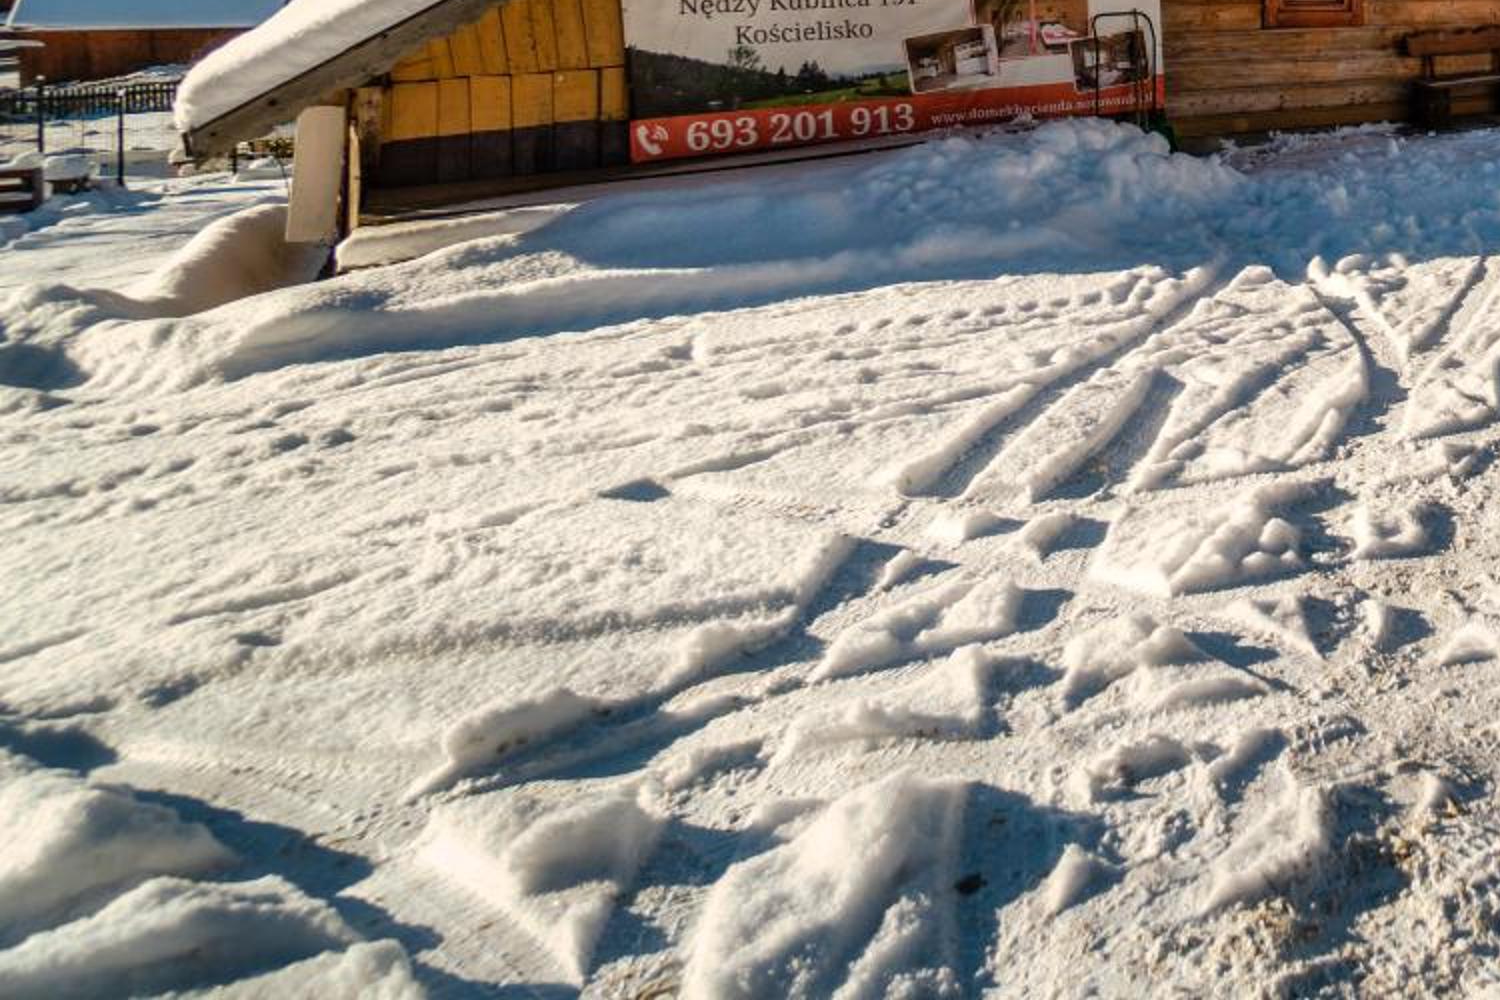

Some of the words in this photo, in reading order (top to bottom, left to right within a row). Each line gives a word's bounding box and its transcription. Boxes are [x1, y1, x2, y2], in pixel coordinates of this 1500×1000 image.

[735, 20, 874, 45] Kościelisko
[686, 117, 758, 151] 693
[769, 109, 840, 143] 201
[850, 103, 915, 136] 913
